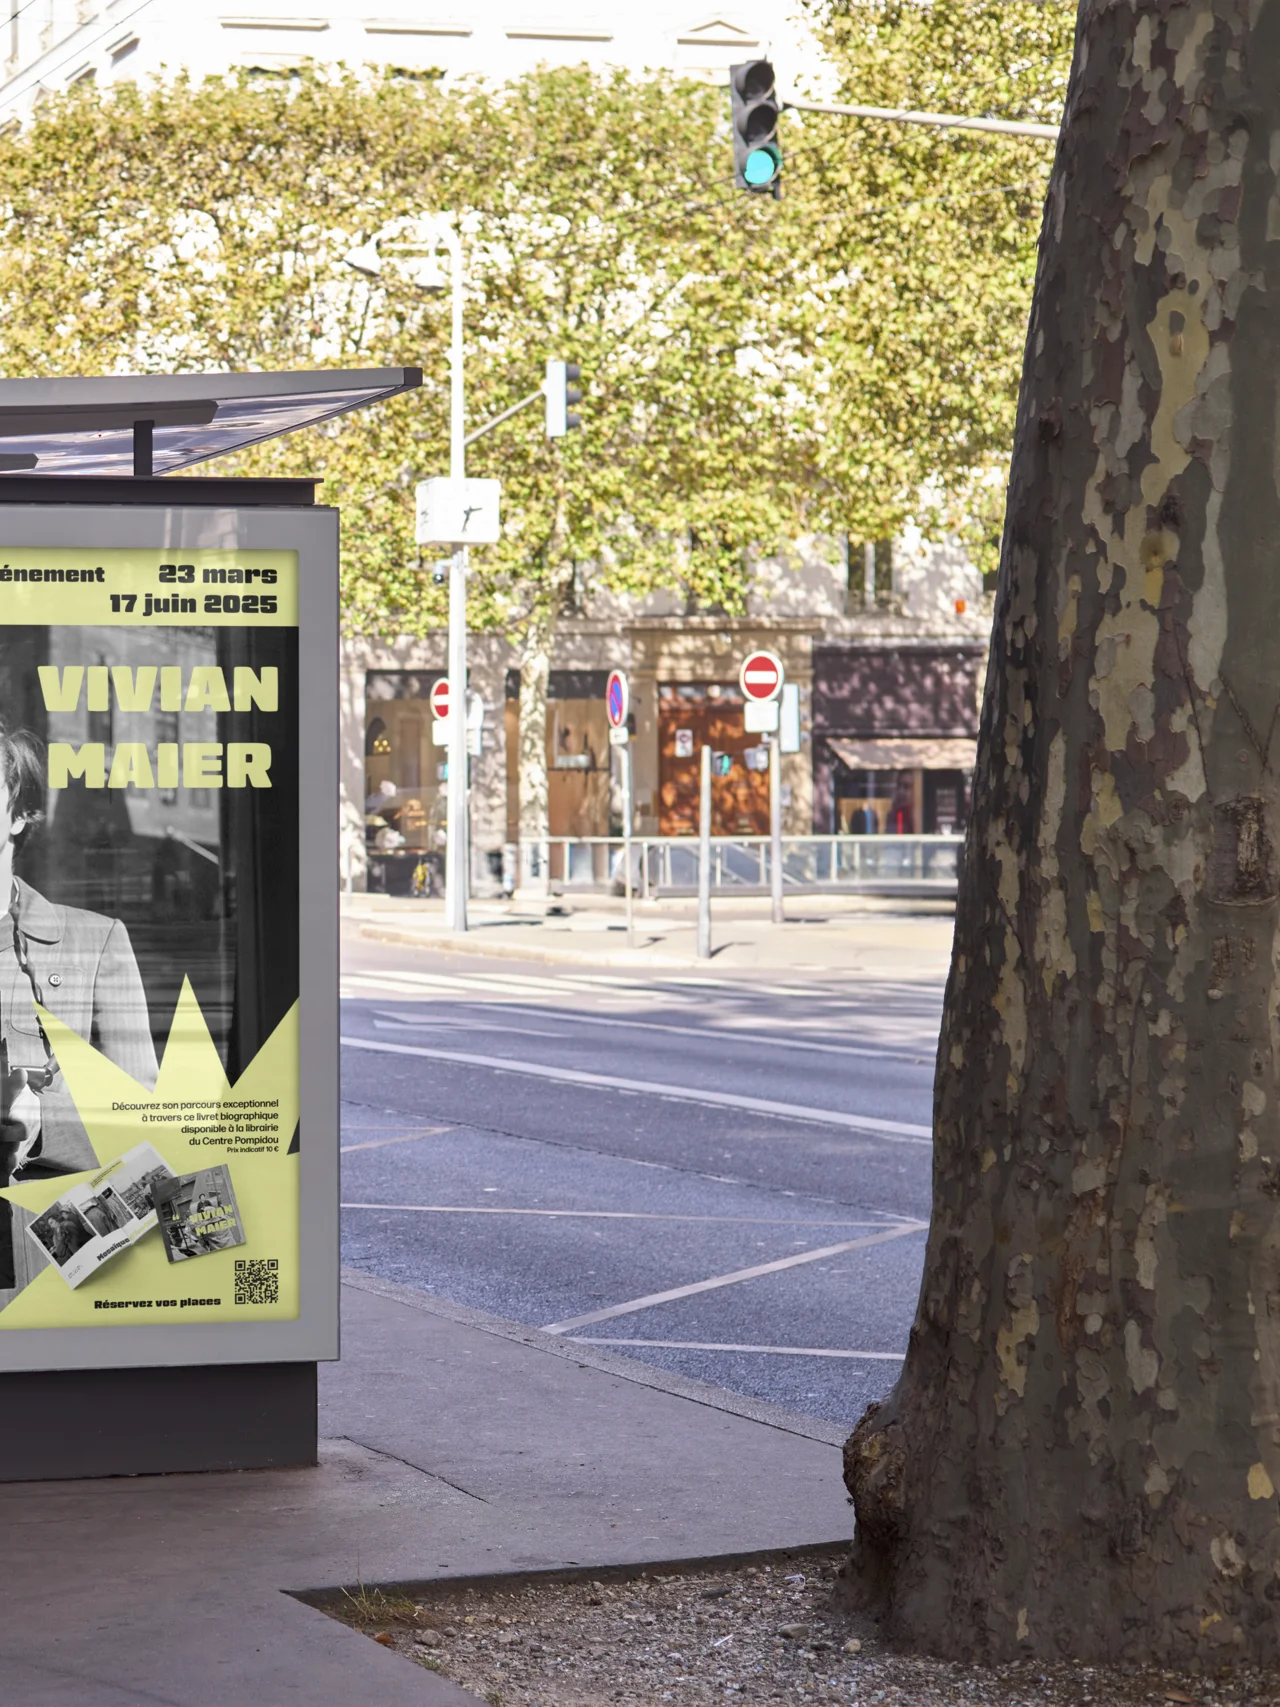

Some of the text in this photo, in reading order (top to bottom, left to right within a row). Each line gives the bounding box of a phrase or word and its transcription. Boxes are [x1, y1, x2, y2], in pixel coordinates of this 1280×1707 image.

[159, 565, 277, 584] 23 mars
[110, 593, 277, 616] 17 juin 2025
[38, 666, 278, 712] VIVIAN
[48, 743, 272, 788] MAIER
[112, 1102, 160, 1110] Découvrez
[181, 1102, 221, 1110] parcours
[223, 1099, 278, 1109] exceptionnel
[142, 1114, 147, 1122] à
[221, 1112, 278, 1121] biographique
[181, 1125, 226, 1134] disponible
[228, 1124, 234, 1132] à
[236, 1124, 244, 1132] la
[203, 1137, 233, 1145] Centre
[235, 1136, 278, 1145] Pompidou
[188, 1204, 233, 1223] VIVIAN
[195, 1217, 236, 1237] MAIER
[96, 1237, 131, 1261] Mosaïque
[95, 1300, 152, 1309] Réservez
[180, 1298, 221, 1308] places
